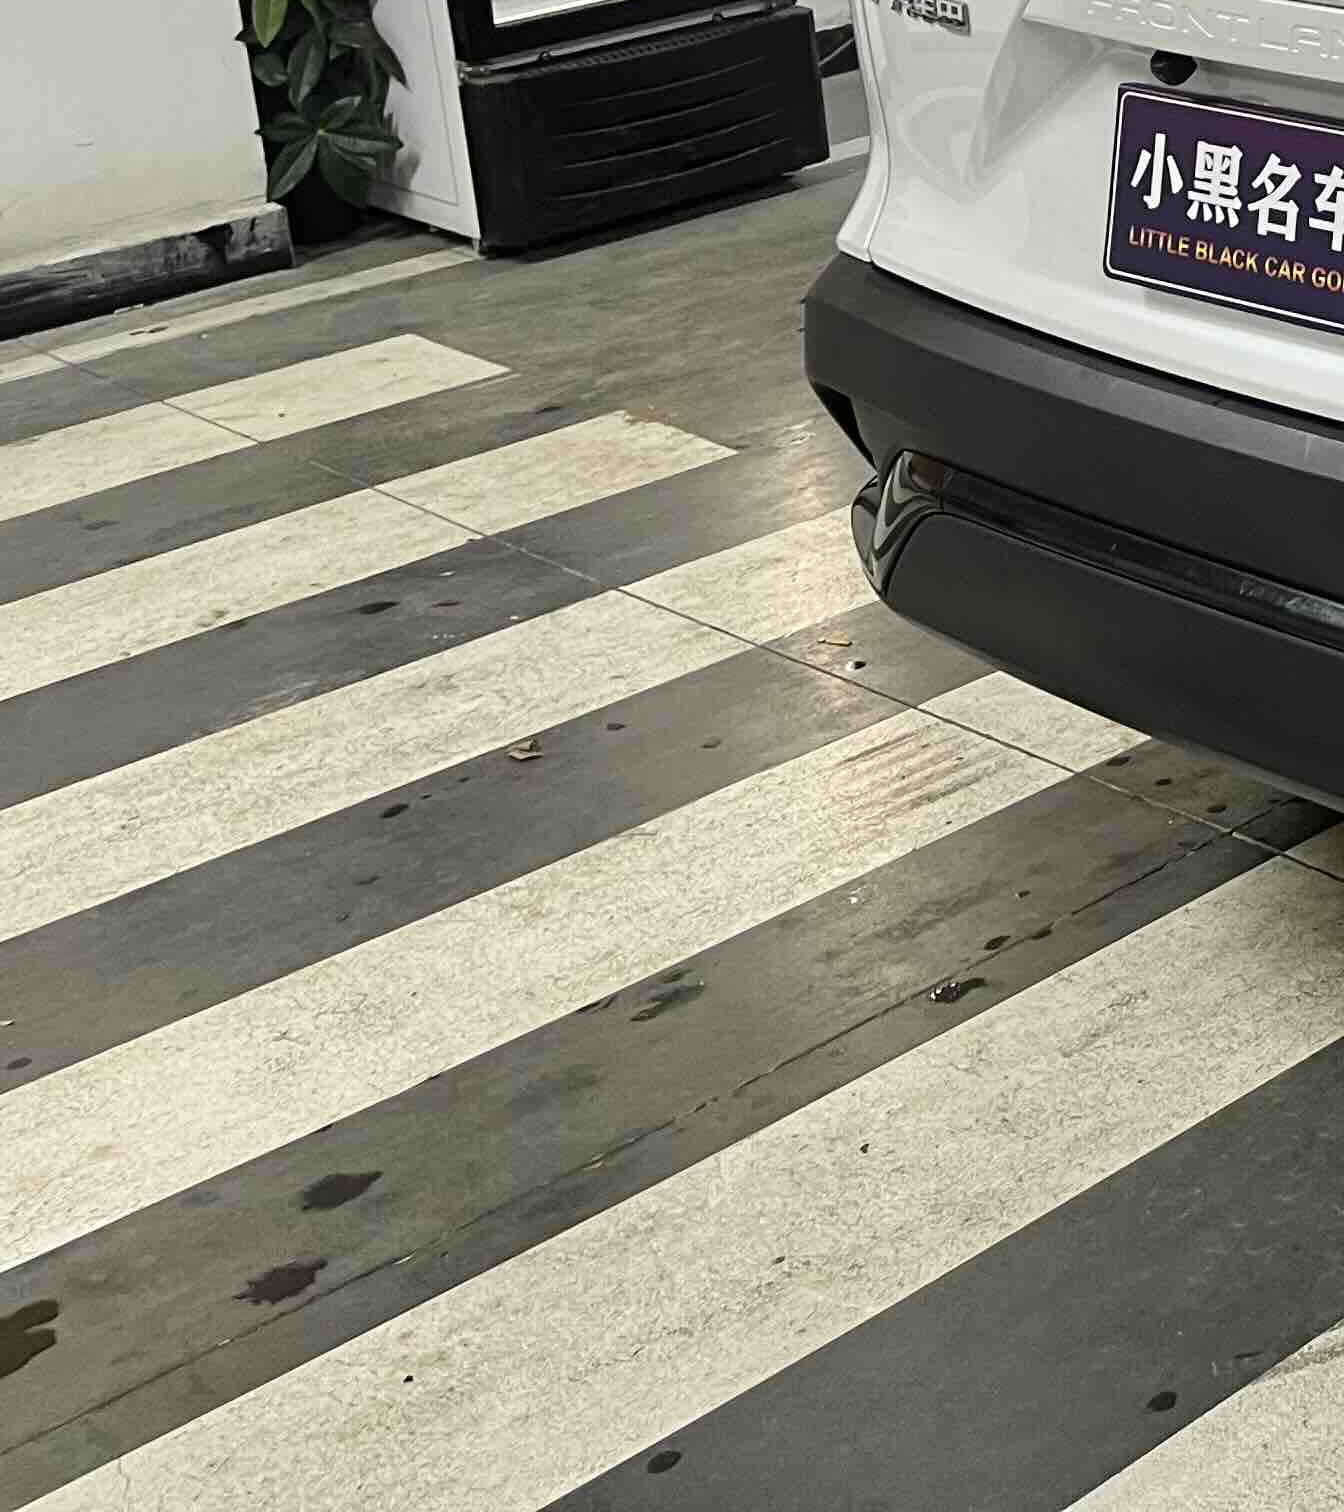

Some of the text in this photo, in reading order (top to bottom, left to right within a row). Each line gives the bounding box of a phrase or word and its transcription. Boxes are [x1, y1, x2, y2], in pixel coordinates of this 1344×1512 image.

[1128, 225, 1190, 258] LITTLE
[1195, 241, 1259, 274] BLACK
[1265, 256, 1306, 283] CAR
